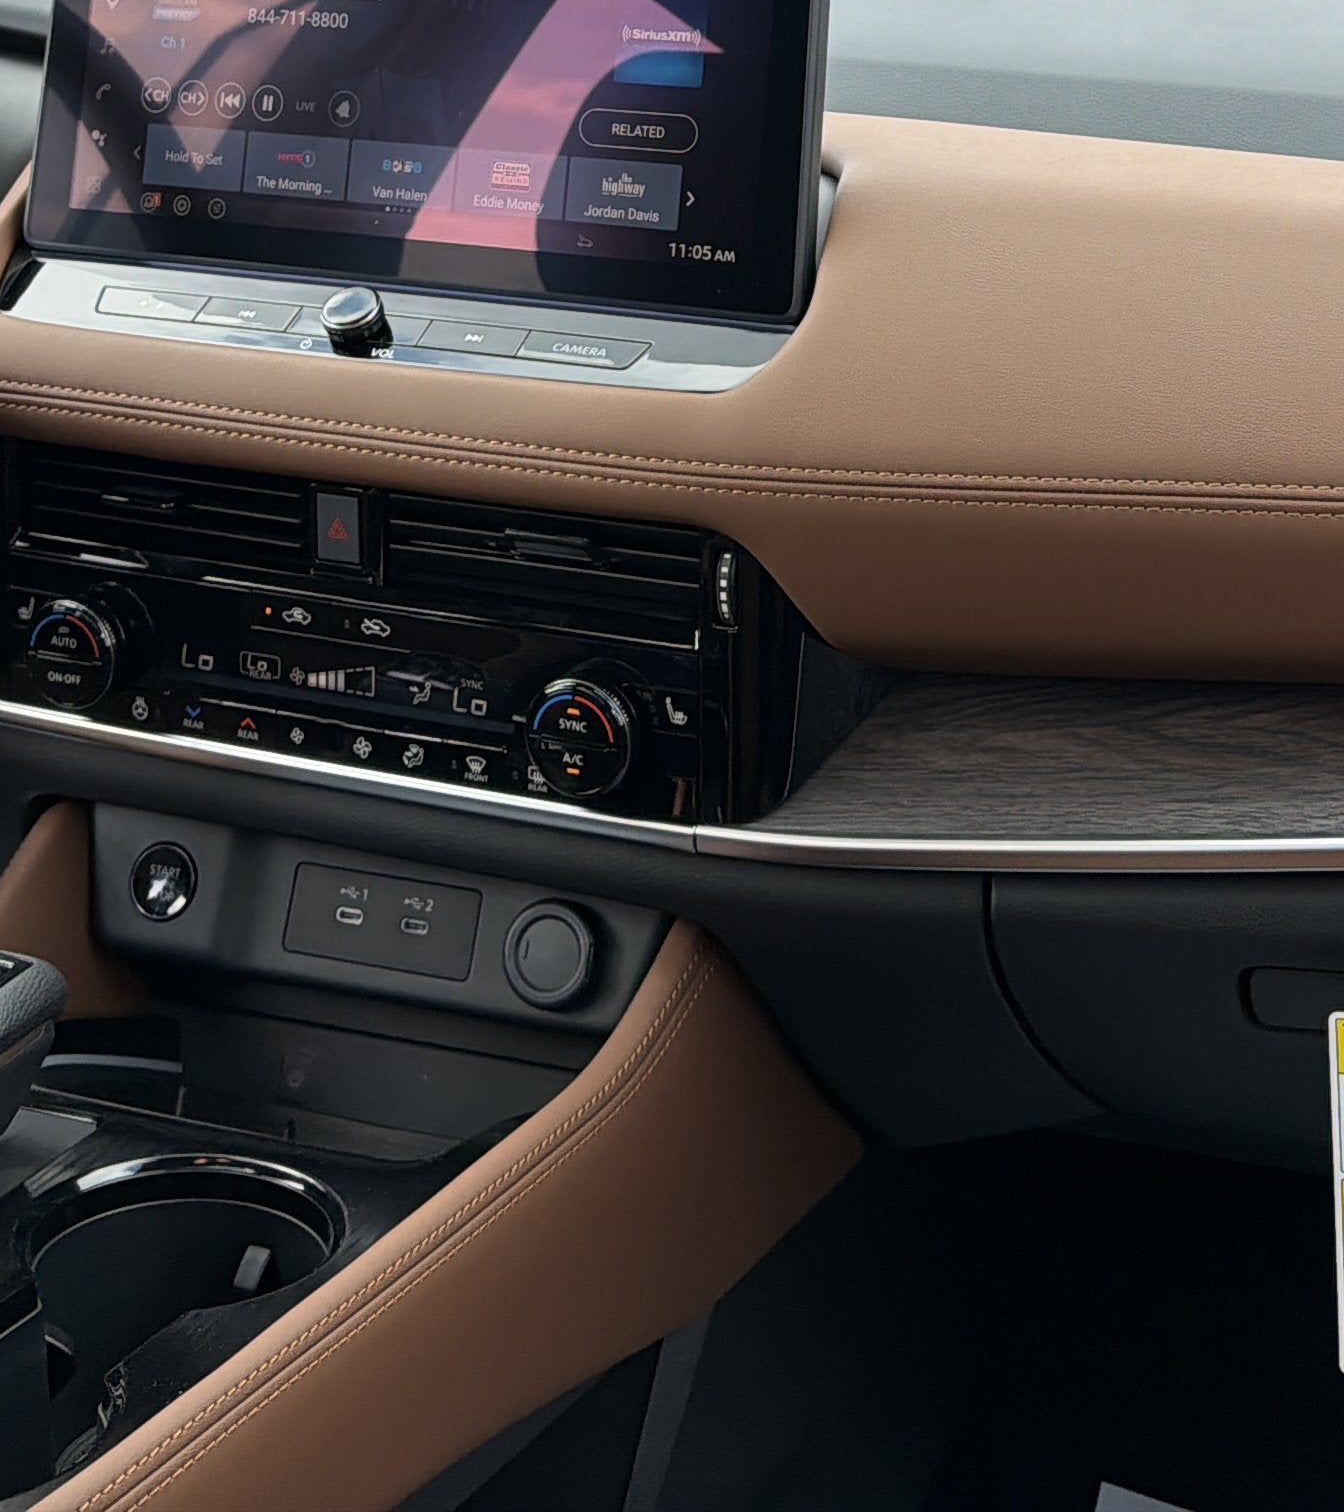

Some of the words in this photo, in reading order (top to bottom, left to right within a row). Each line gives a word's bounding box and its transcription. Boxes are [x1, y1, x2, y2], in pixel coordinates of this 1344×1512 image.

[248, 8, 349, 29] 844-711-8800
[160, 36, 176, 49] Ch
[180, 37, 186, 49] 1
[181, 92, 196, 104] CH
[295, 102, 316, 112] LIVE
[611, 123, 665, 139] RELATED
[165, 150, 188, 163] Hold
[190, 152, 204, 163] To
[206, 153, 223, 166] Set
[257, 176, 276, 188] The
[285, 178, 322, 196] Morning
[602, 177, 646, 198] highway
[372, 186, 394, 200] Van
[397, 188, 428, 202] Halen
[473, 195, 503, 209] Eddie
[507, 197, 544, 214] Money
[584, 204, 625, 220] Jordan
[628, 209, 659, 223] Davis
[669, 242, 712, 261] 11:05
[714, 249, 736, 263] AM
[371, 347, 395, 359] VOL
[552, 343, 606, 357] CAMERA
[51, 635, 77, 649] AUTO
[249, 669, 272, 680] REAR
[461, 678, 483, 689] SYNC
[183, 718, 204, 730] REAR
[559, 718, 588, 733] SYNC
[237, 728, 259, 741] REAR
[562, 753, 584, 766] A/C
[464, 771, 489, 783] FRONT
[149, 864, 181, 878] START
[425, 899, 434, 912] 2
